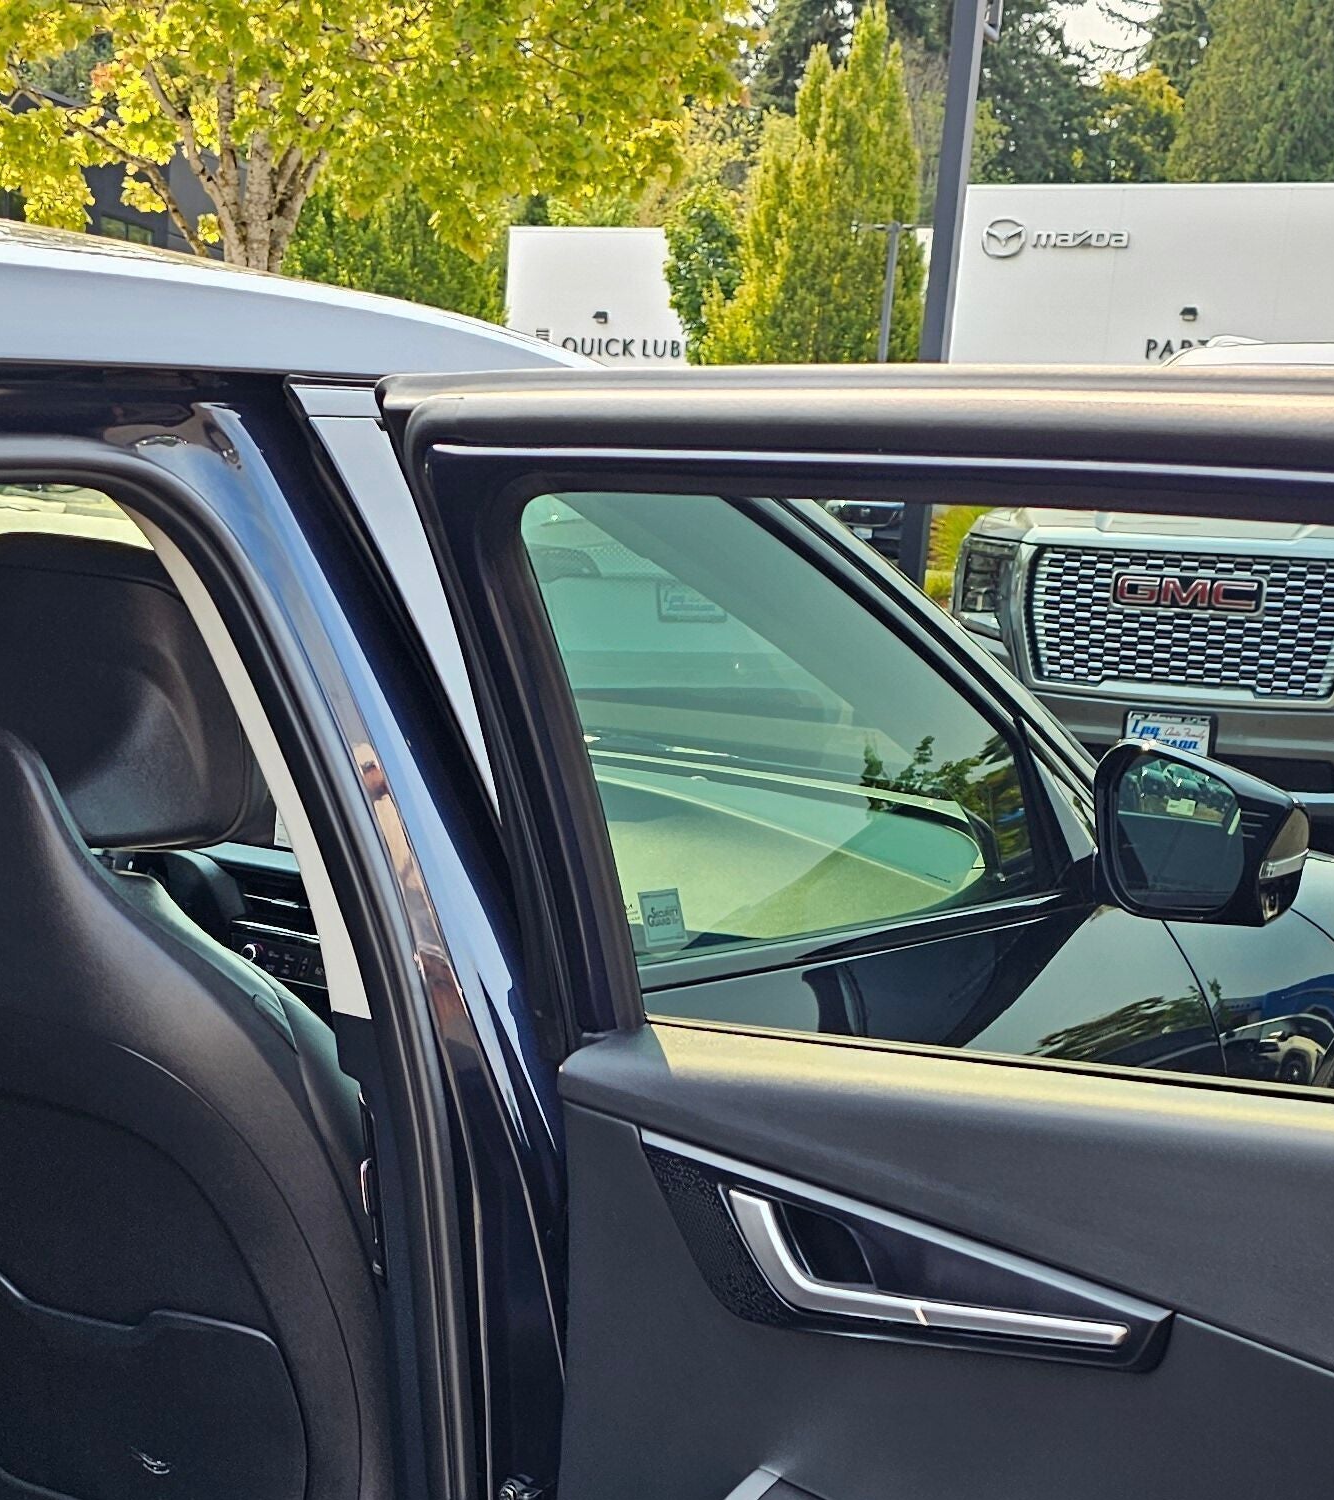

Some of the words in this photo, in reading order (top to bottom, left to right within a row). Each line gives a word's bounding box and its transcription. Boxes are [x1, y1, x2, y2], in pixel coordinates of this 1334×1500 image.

[1031, 230, 1130, 248] mazda
[562, 337, 636, 358] QUICK
[642, 338, 688, 358] LUB
[1117, 574, 1258, 611] GMC
